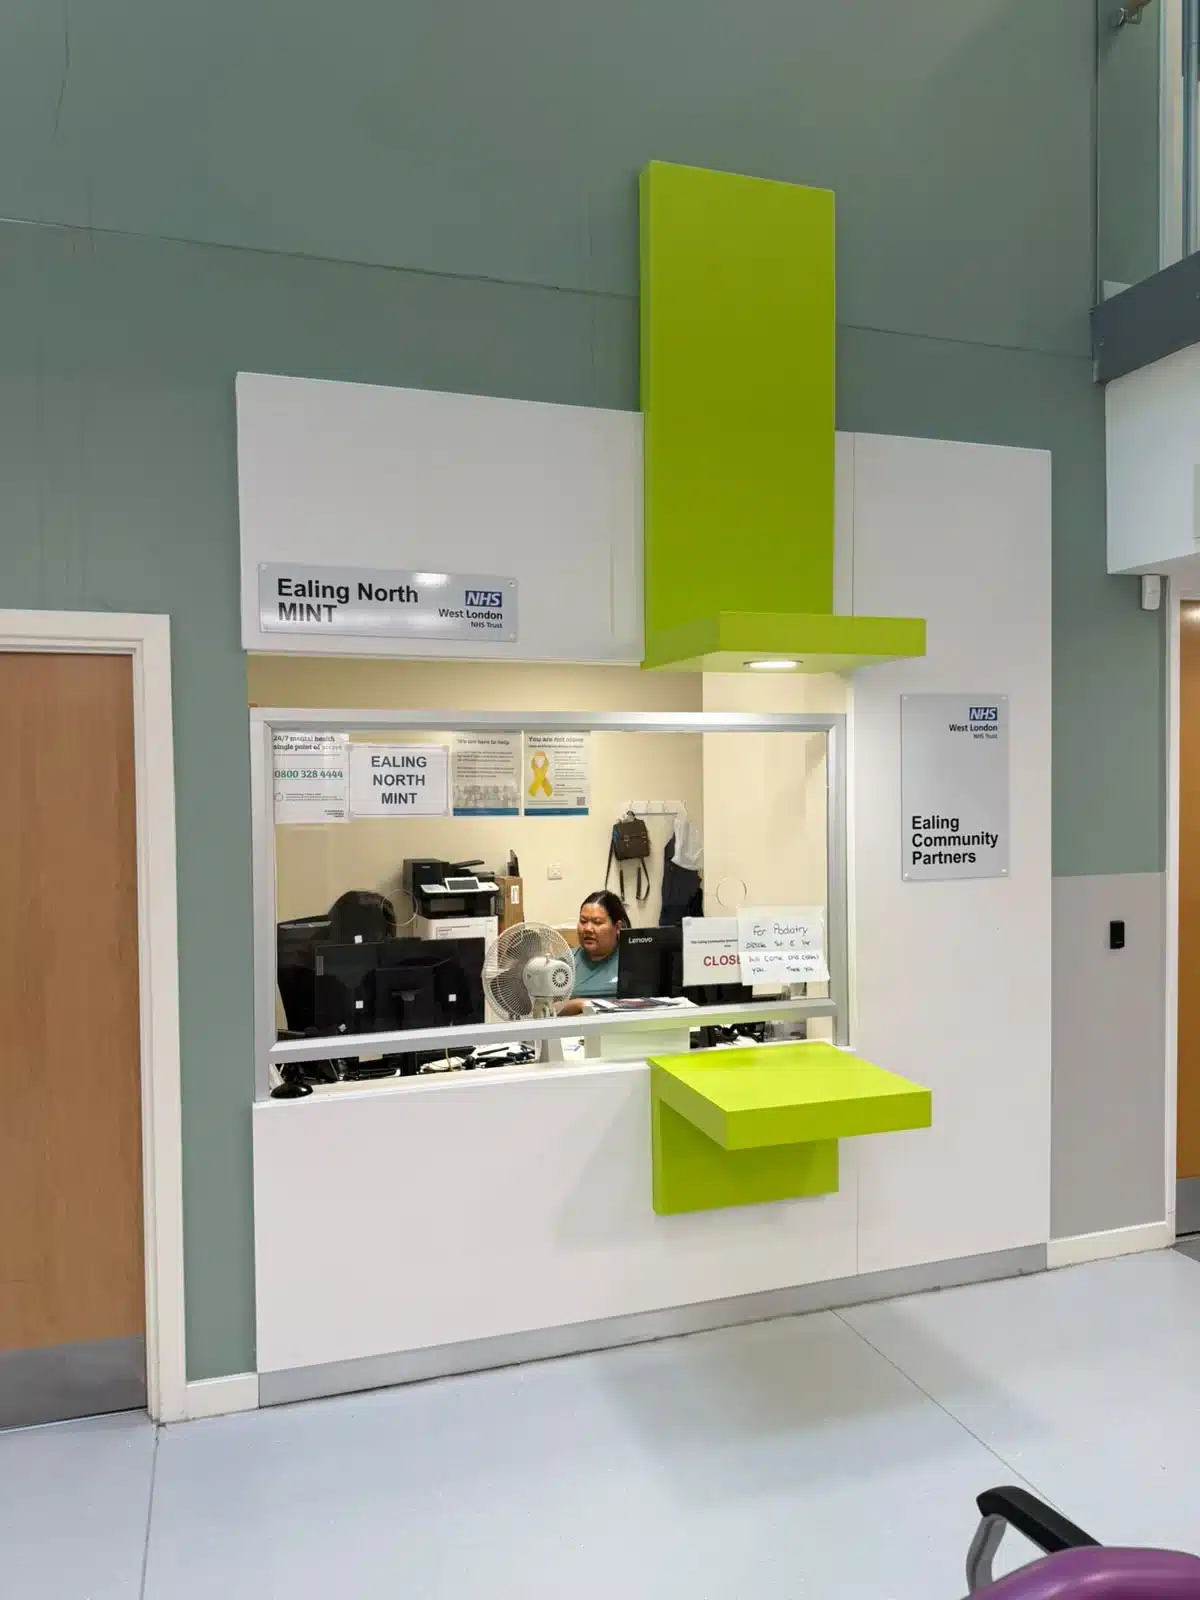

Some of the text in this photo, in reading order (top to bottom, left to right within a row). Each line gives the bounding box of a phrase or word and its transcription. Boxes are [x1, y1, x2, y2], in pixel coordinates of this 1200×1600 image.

[277, 578, 419, 604] Ealing North
[466, 591, 502, 606] NHS
[278, 602, 338, 623] MINT
[438, 608, 503, 620] West London
[470, 621, 503, 629] NHS Trust
[970, 707, 997, 721] NHS
[949, 723, 998, 732] West London
[273, 743, 294, 751] single
[294, 743, 312, 751] point
[371, 755, 427, 768] EALING
[274, 770, 344, 778] 0800 328 4444
[373, 774, 426, 786] NORTH
[381, 792, 418, 805] MINT
[912, 815, 960, 832] Ealing
[911, 831, 999, 848] Community
[912, 850, 977, 865] Partners
[753, 924, 766, 936] For
[628, 936, 653, 944] Lenovo
